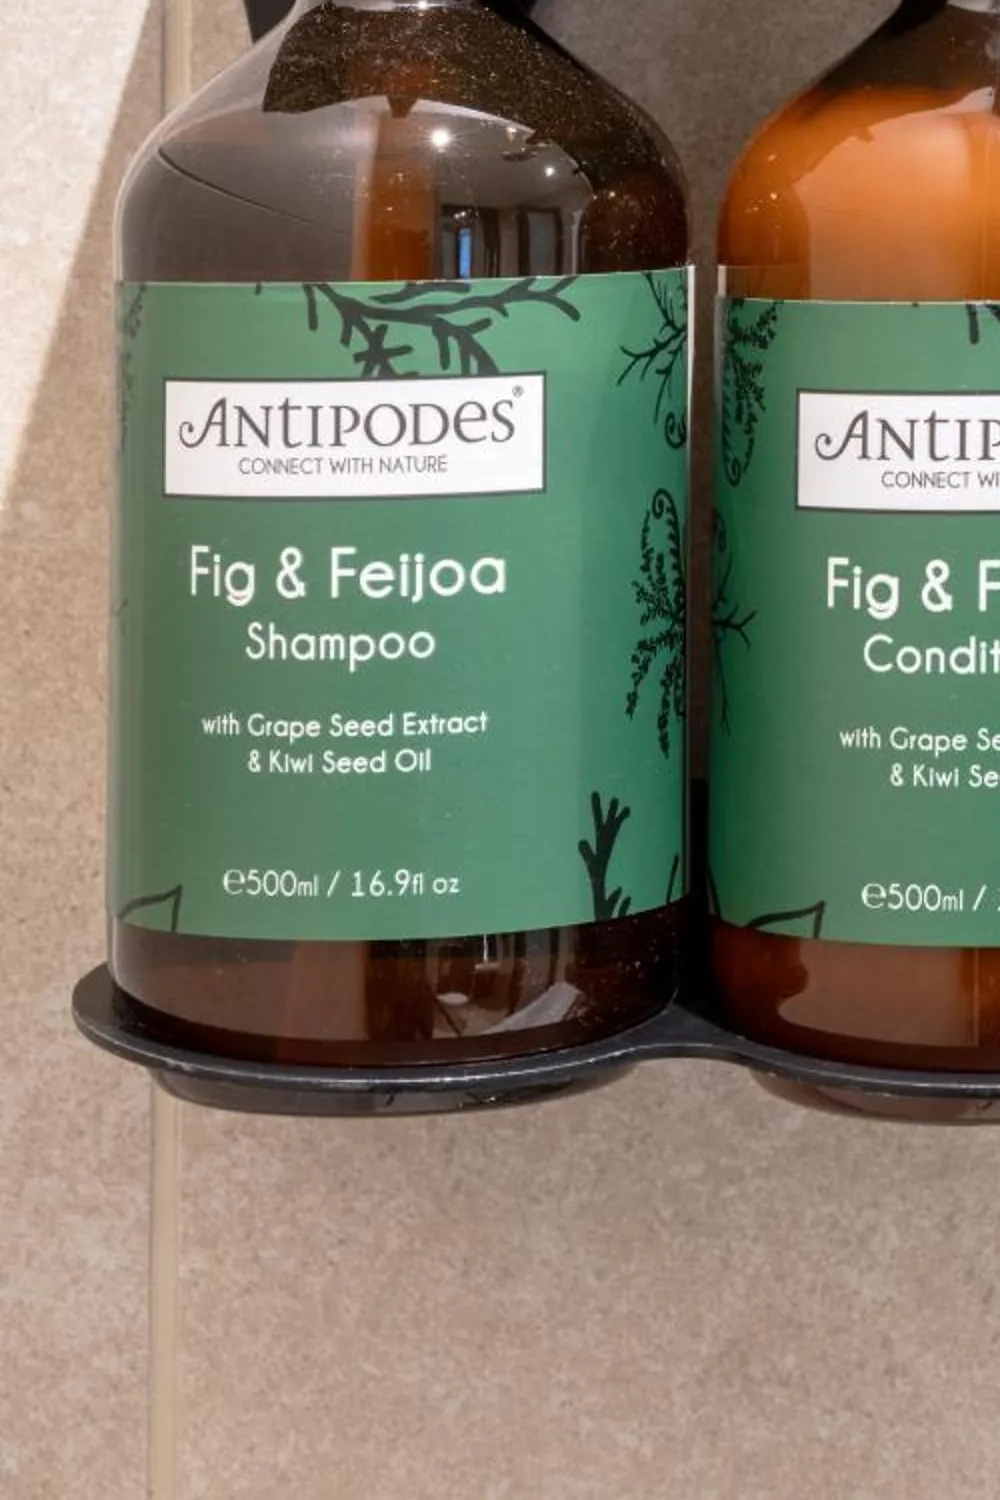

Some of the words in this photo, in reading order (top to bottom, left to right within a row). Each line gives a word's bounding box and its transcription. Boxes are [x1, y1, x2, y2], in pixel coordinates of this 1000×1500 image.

[237, 456, 324, 476] CONNECT
[328, 457, 374, 475] WITH
[379, 454, 448, 474] NATURE
[880, 470, 971, 489] CONNECT
[191, 544, 256, 607] Fig
[276, 546, 306, 599] &
[330, 546, 506, 604] Feijoa
[827, 556, 900, 621] Fig
[921, 559, 953, 613] &
[245, 621, 436, 674] Shampoo
[201, 712, 240, 736] with
[247, 712, 322, 745] Grape
[329, 712, 394, 738] Seed
[402, 711, 488, 736] Extract
[839, 725, 882, 749] with
[889, 726, 968, 759] Grape
[247, 749, 262, 773] &
[269, 749, 314, 773] Kiwi
[321, 749, 387, 774] Seed
[394, 747, 431, 773] Oil
[889, 762, 904, 787] &
[913, 763, 960, 788] Kiwi
[326, 870, 341, 898] /
[432, 877, 460, 895] oz
[972, 884, 987, 912] /
